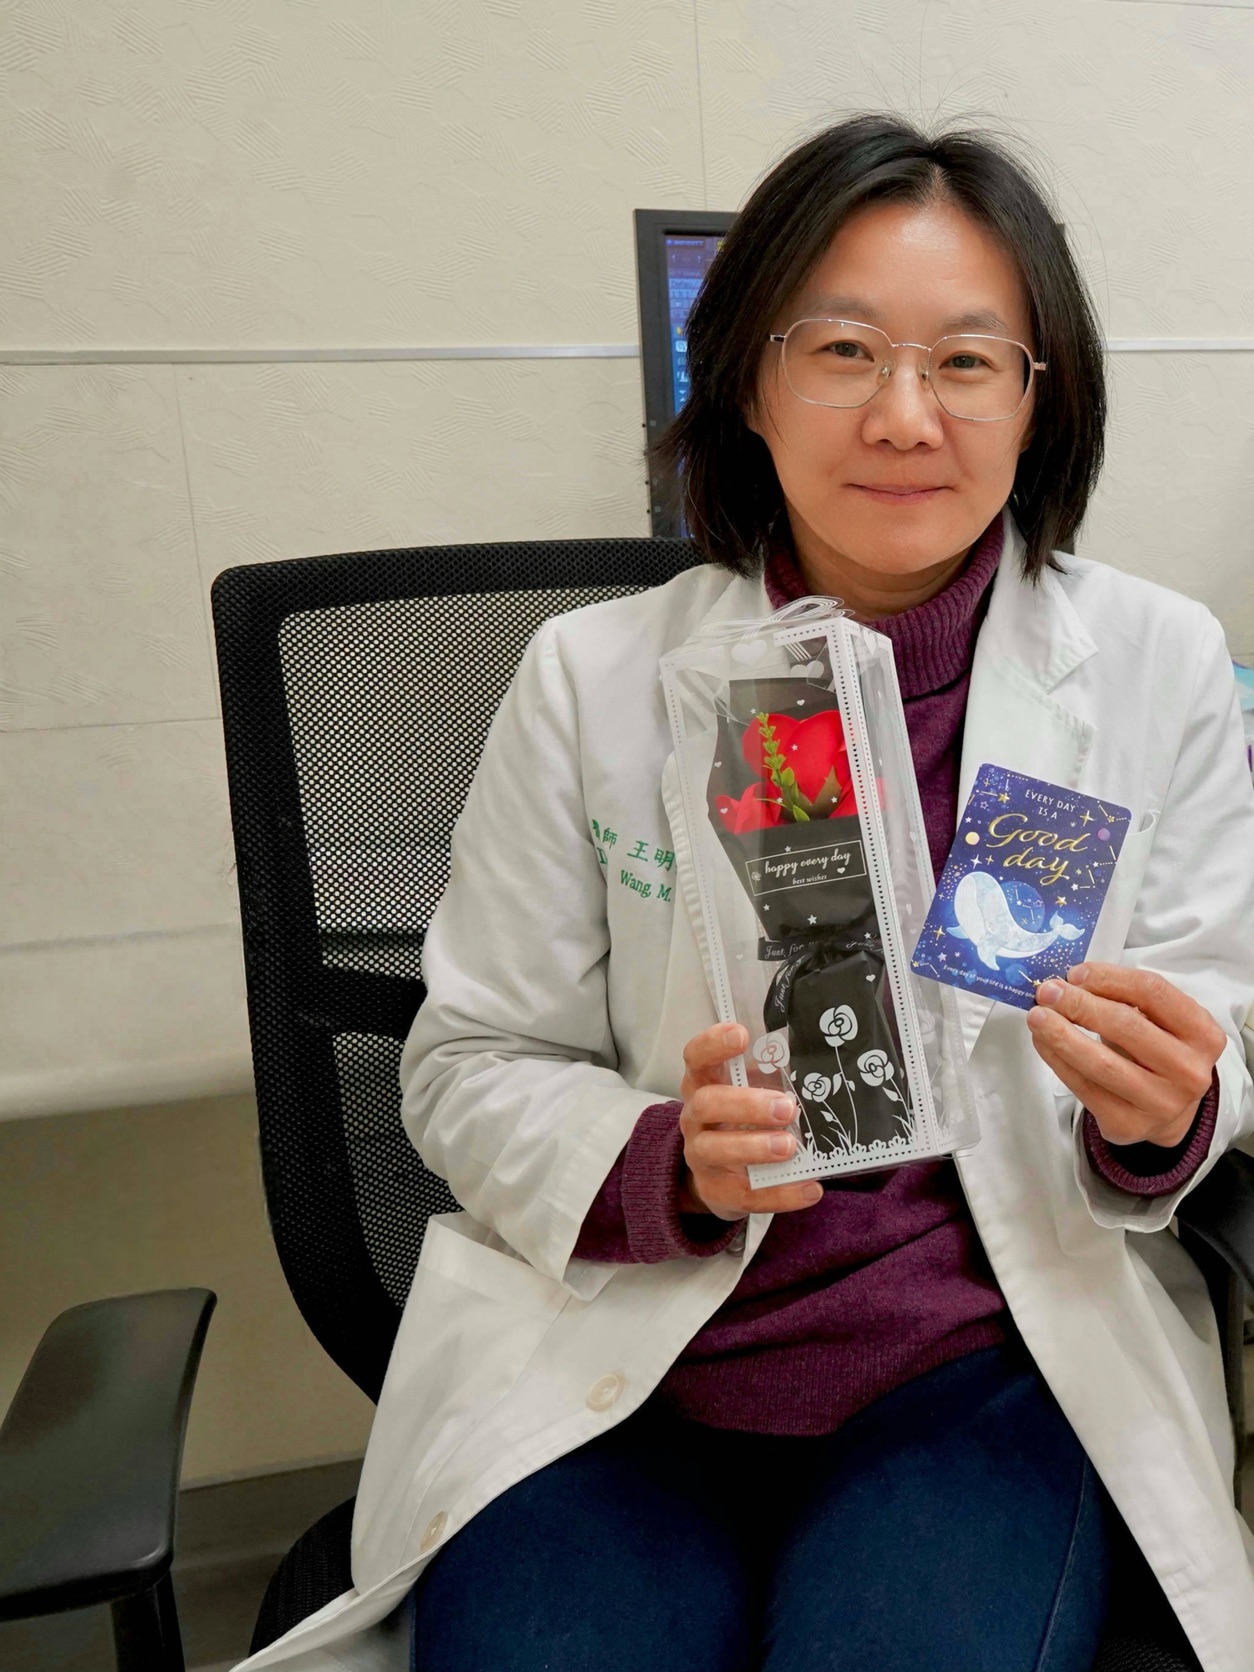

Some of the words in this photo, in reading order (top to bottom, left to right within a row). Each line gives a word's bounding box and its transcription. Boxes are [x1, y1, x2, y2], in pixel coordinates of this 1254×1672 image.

[1025, 789, 1054, 806] EVERY
[1057, 799, 1076, 812] DAY
[1038, 807, 1049, 816] IS
[1051, 811, 1058, 820] A
[986, 813, 1091, 853] Good
[765, 860, 799, 878] happy
[800, 856, 829, 870] every
[831, 848, 851, 866] day
[1003, 847, 1070, 886] day
[620, 869, 652, 898] Wang
[792, 877, 805, 886] best
[806, 873, 827, 883] wishes
[764, 945, 786, 960] Just
[785, 943, 804, 959] for
[943, 964, 959, 975] Every
[959, 970, 969, 978] day
[1008, 986, 1025, 996] happy
[774, 984, 789, 1013] Just
